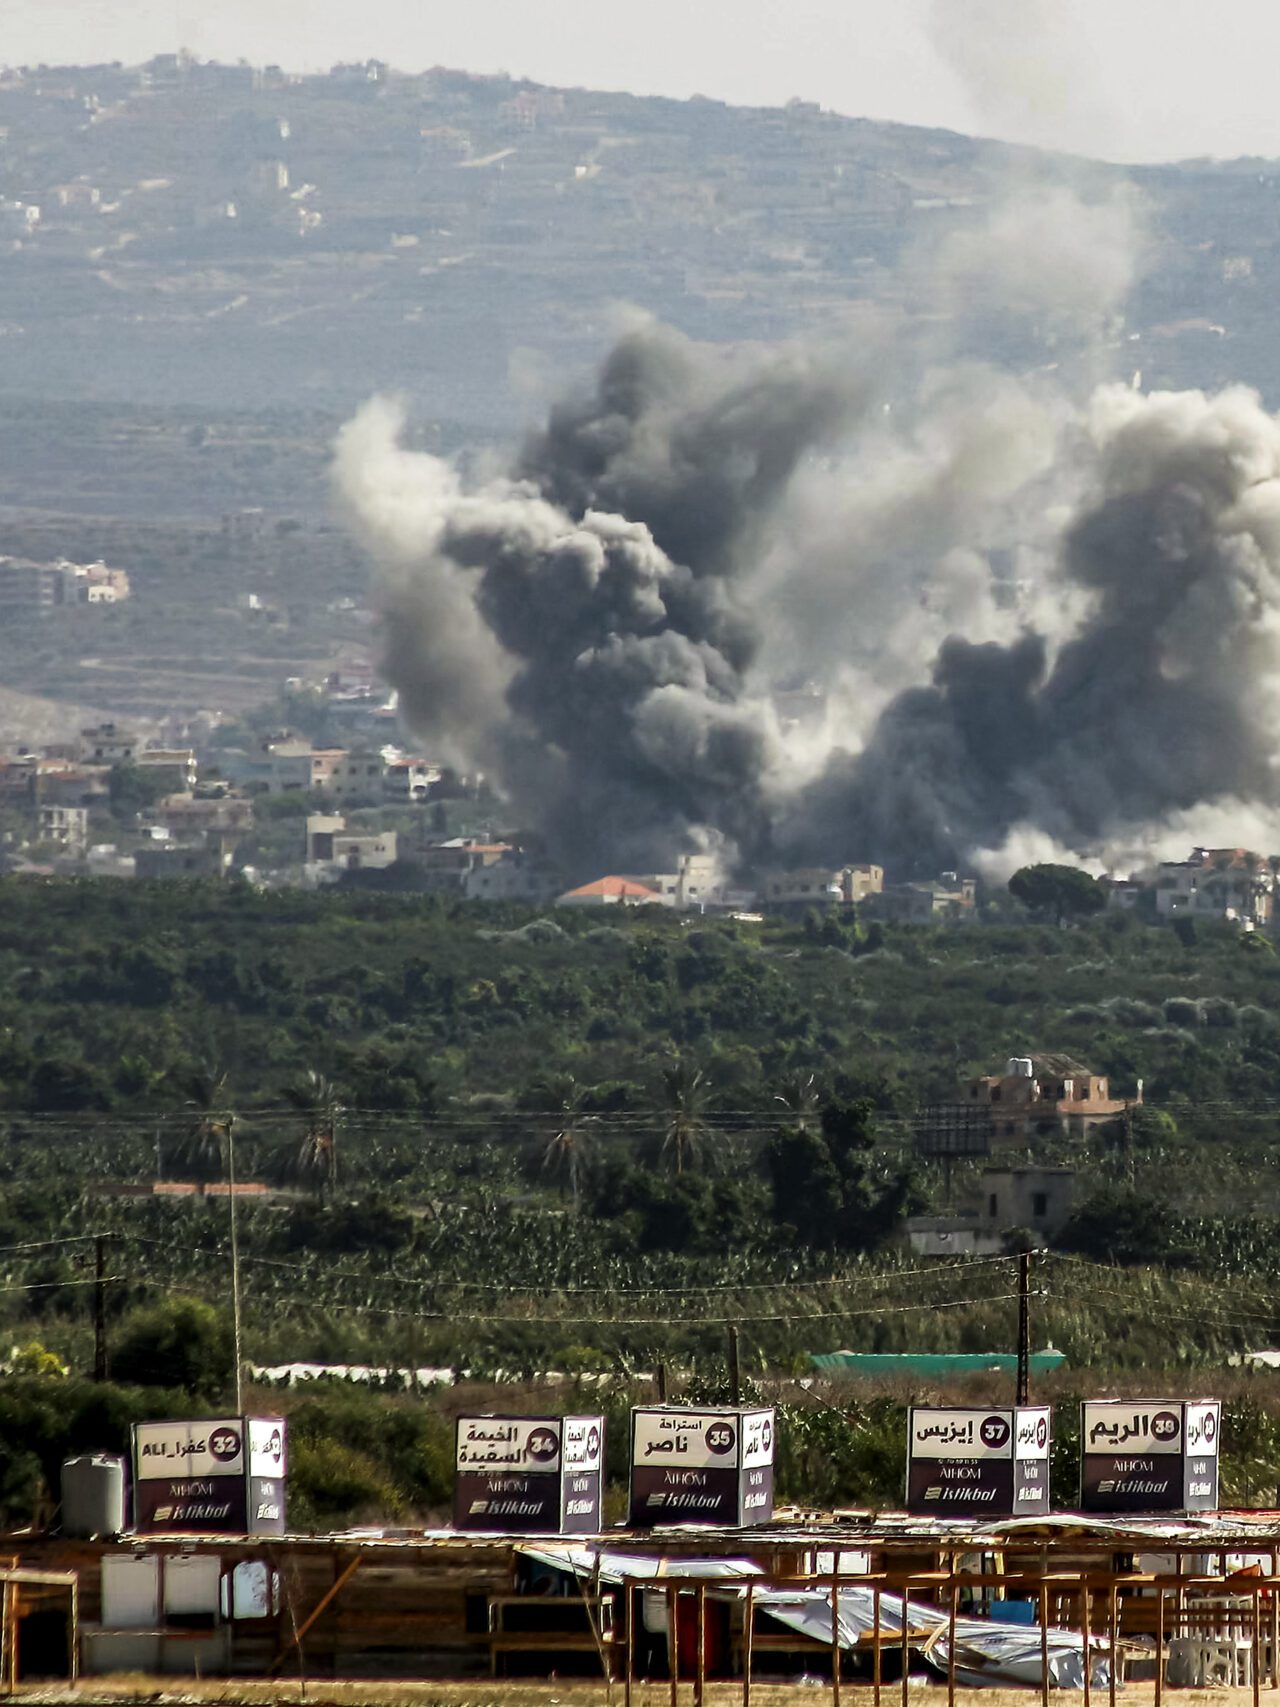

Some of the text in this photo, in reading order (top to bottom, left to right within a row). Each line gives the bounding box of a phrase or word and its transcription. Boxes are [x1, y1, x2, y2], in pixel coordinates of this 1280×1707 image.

[467, 1424, 518, 1442] الخيمة
[659, 1418, 702, 1432] استراحة
[917, 1420, 1005, 1445] 37 إيزيس
[1090, 1415, 1175, 1445] 38 الريم
[213, 1435, 237, 1454] 32
[530, 1437, 555, 1454] 34
[644, 1435, 688, 1457] ناصر
[710, 1431, 731, 1446] 35
[459, 1443, 527, 1469] السعيدة
[942, 1487, 997, 1501] istikbal
[1115, 1480, 1168, 1493] istikbal
[488, 1501, 543, 1515] istikbal
[665, 1492, 722, 1508] istikbal
[172, 1502, 231, 1520] istikbal
